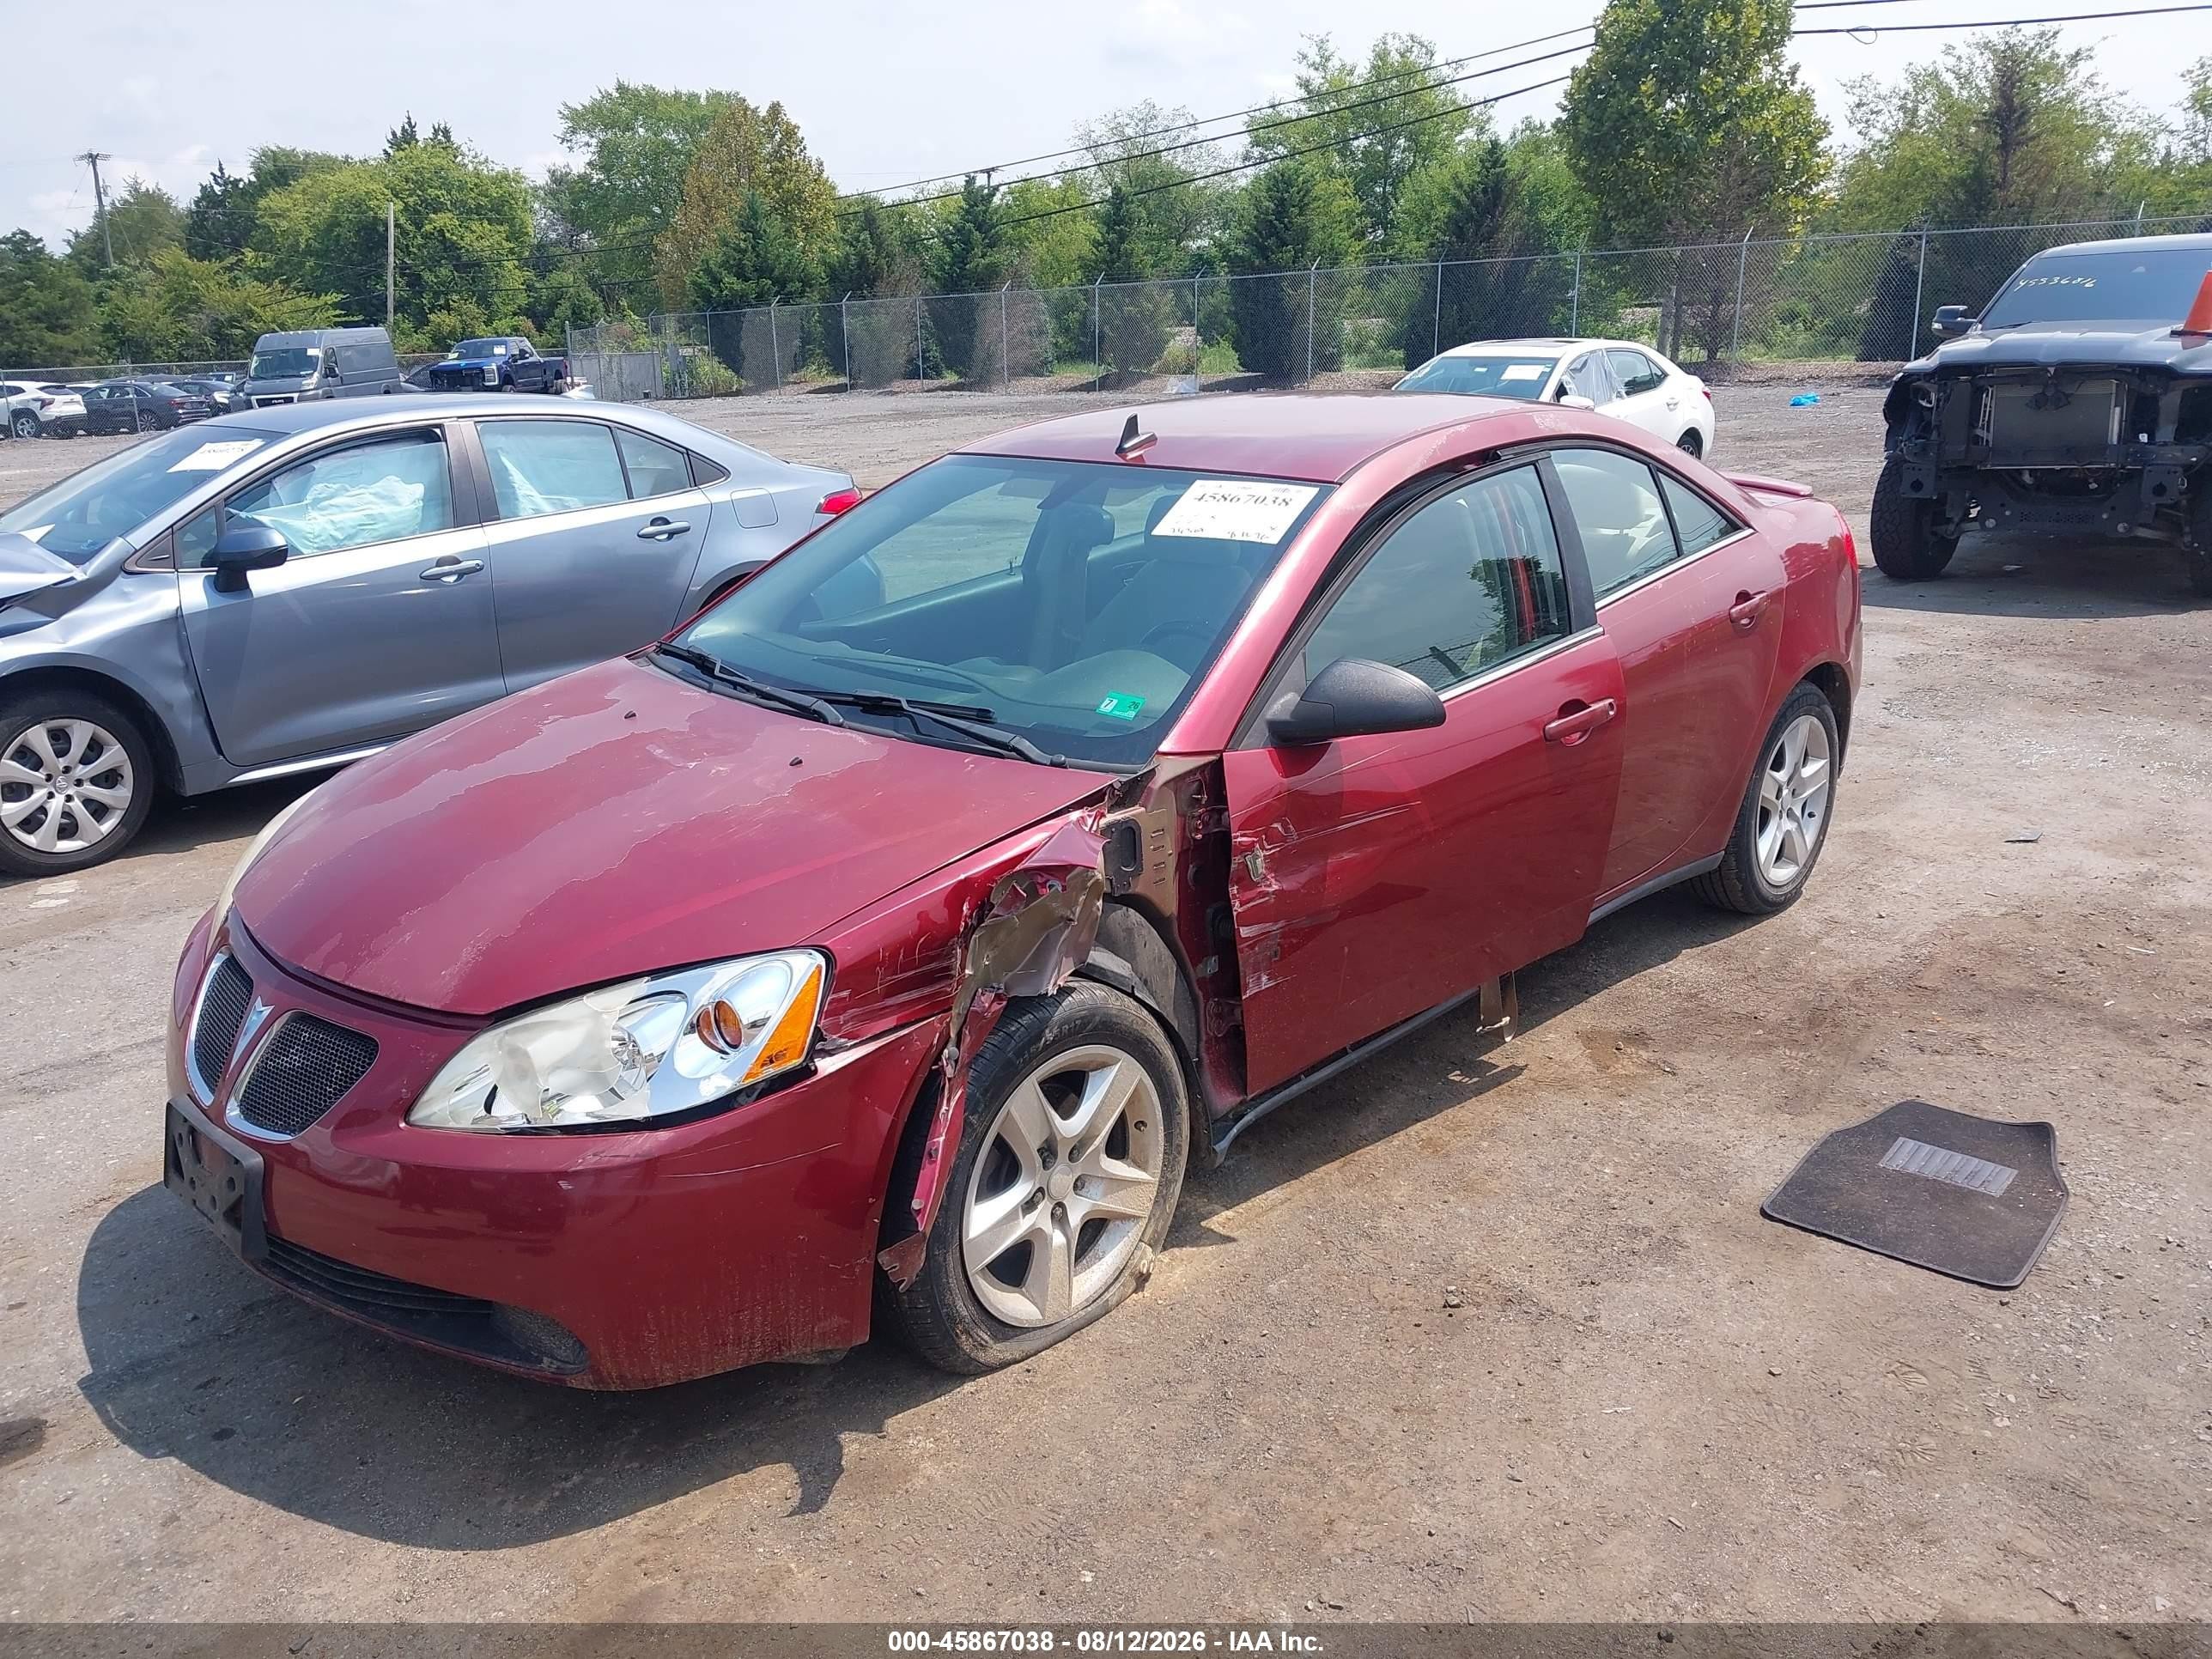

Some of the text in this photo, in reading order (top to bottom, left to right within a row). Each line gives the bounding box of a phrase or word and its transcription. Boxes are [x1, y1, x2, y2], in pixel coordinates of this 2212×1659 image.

[1193, 492, 1292, 507] 45867038
[1103, 699, 1141, 710] 7 26
